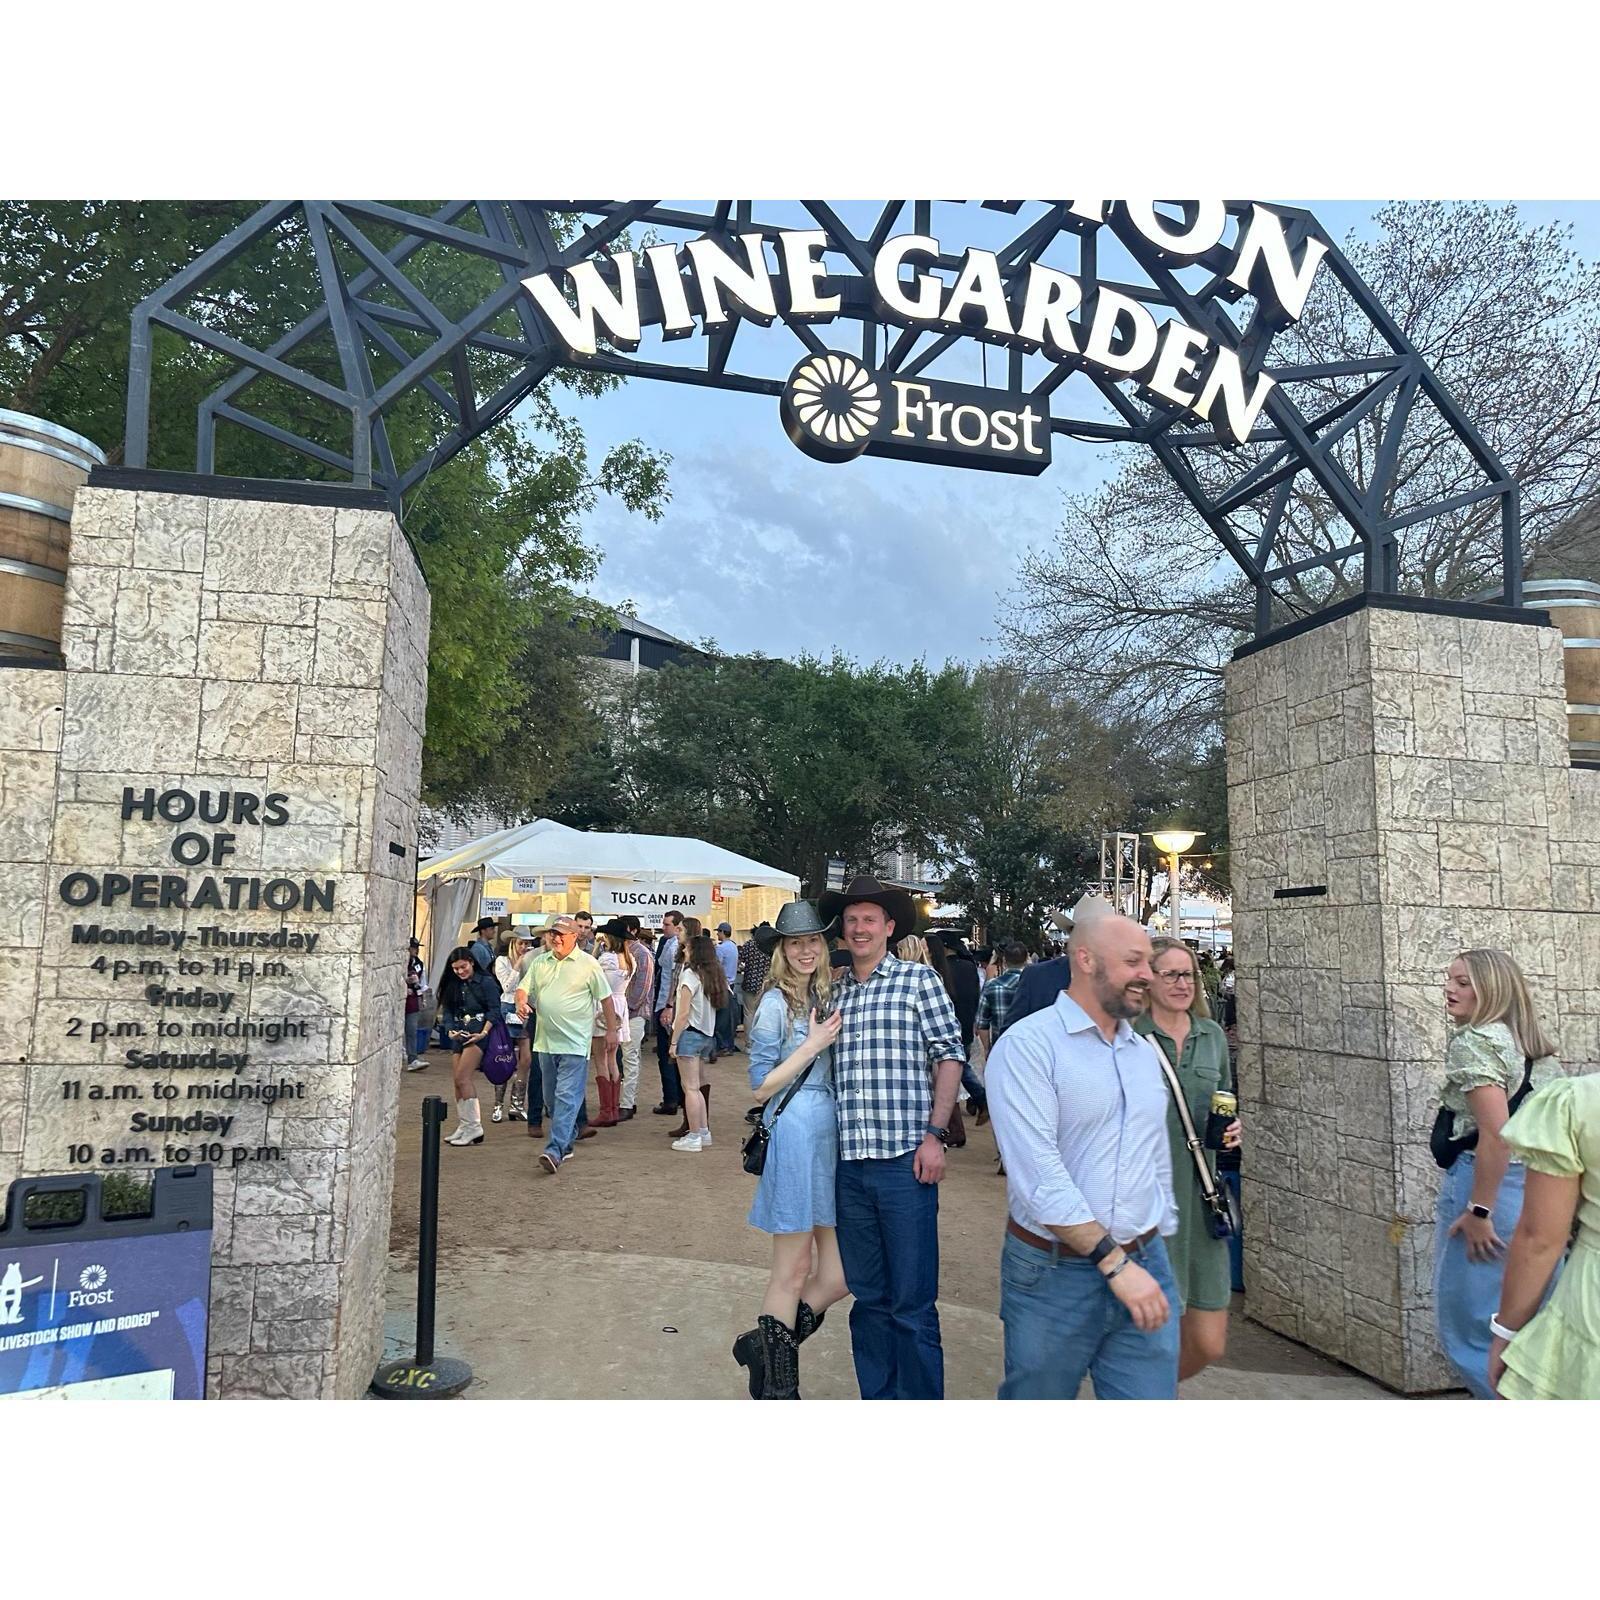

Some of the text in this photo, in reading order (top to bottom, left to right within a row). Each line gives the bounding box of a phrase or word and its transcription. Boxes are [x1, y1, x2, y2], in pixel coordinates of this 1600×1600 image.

[1067, 200, 1329, 322] ON
[522, 229, 1278, 444] WINE GARDEN
[891, 378, 1044, 456] Frost
[121, 787, 290, 826] HOURS
[171, 832, 235, 866] OF
[59, 872, 335, 912] OPERATION
[611, 892, 696, 906] TUSCAN BAR
[71, 924, 320, 954] Monday-Thursday
[91, 955, 294, 983] 4 p.m. to 11 p.m.
[148, 985, 235, 1013] Friday
[66, 1016, 309, 1043] 2 p.m. to midnight
[124, 1048, 250, 1075] Saturday
[62, 1078, 306, 1105] 11 a.m. to midnight
[129, 1110, 235, 1138] Sunday
[67, 1142, 287, 1169] 10 a.m. to 10 p.m.
[67, 1288, 114, 1308] Frost
[0, 1327, 59, 1350] LIVESTOCK
[59, 1322, 93, 1341] SHOW
[93, 1318, 117, 1335] AND
